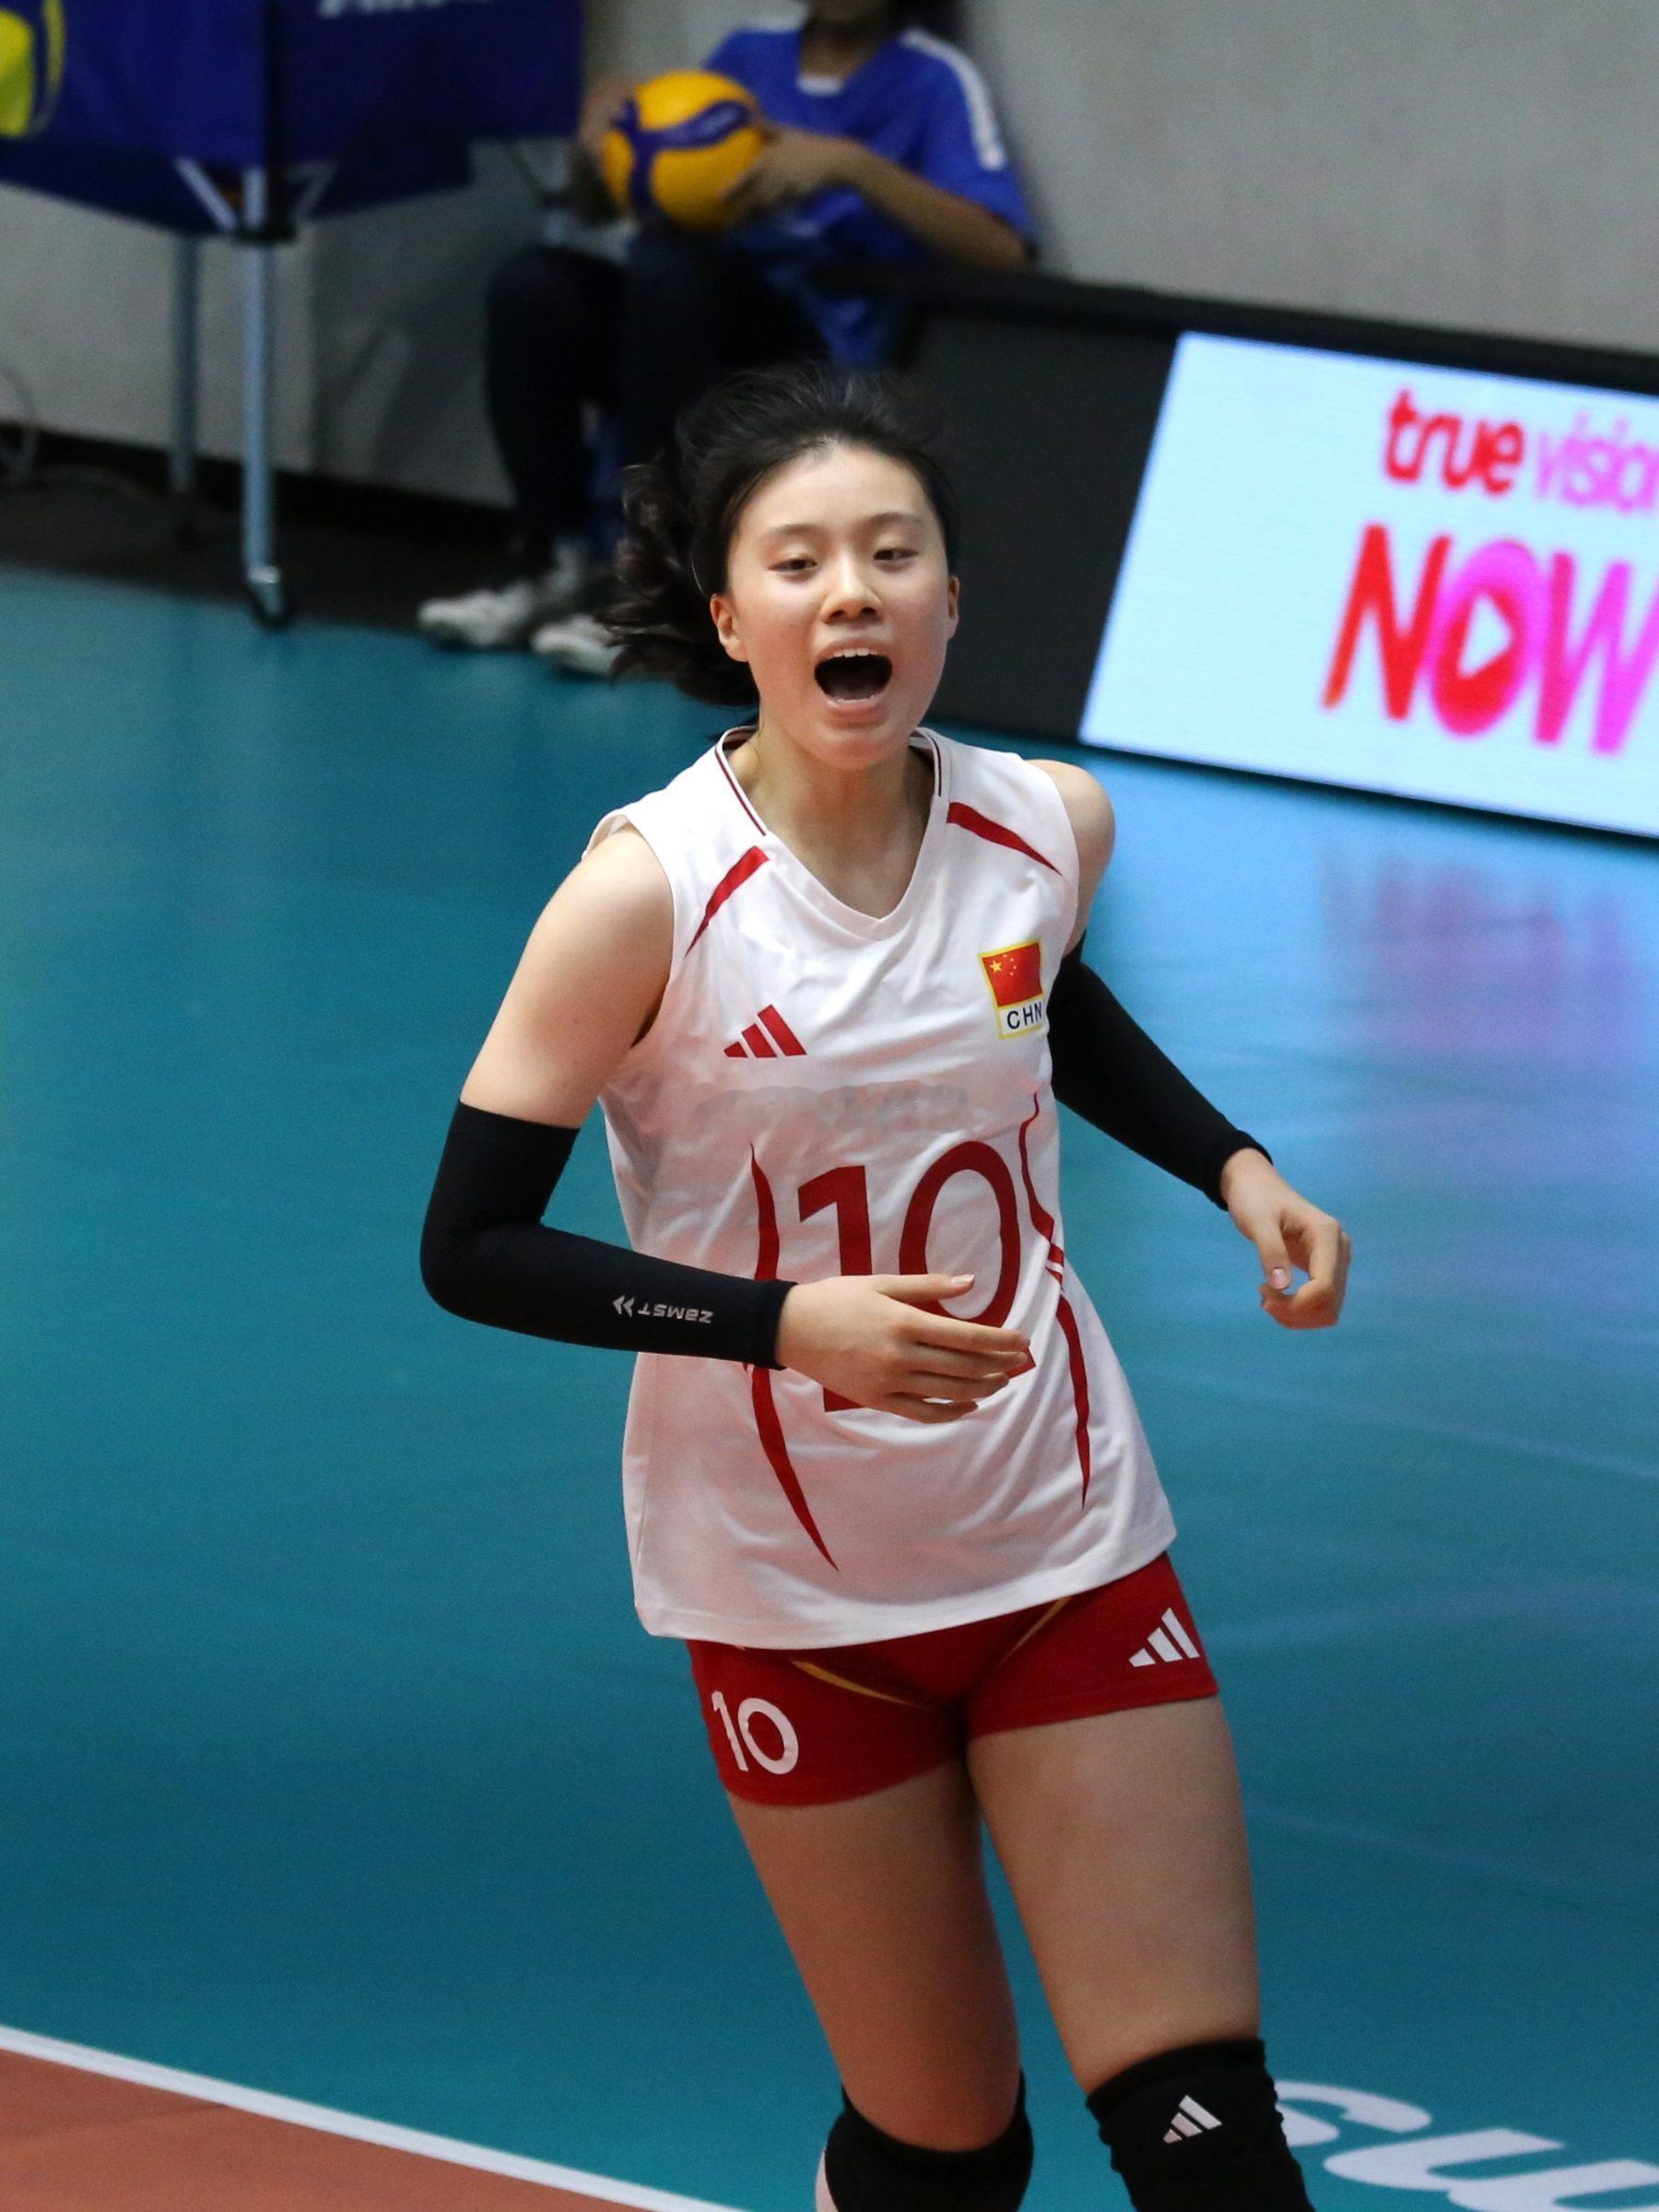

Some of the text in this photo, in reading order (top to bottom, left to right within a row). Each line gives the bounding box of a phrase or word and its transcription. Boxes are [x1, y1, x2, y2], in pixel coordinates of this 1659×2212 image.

[1384, 389, 1524, 496] true
[1324, 523, 1659, 756] NOW
[1006, 1001, 1042, 1030] CHN
[797, 1140, 1021, 1335] 10
[711, 1689, 800, 1775] 10
